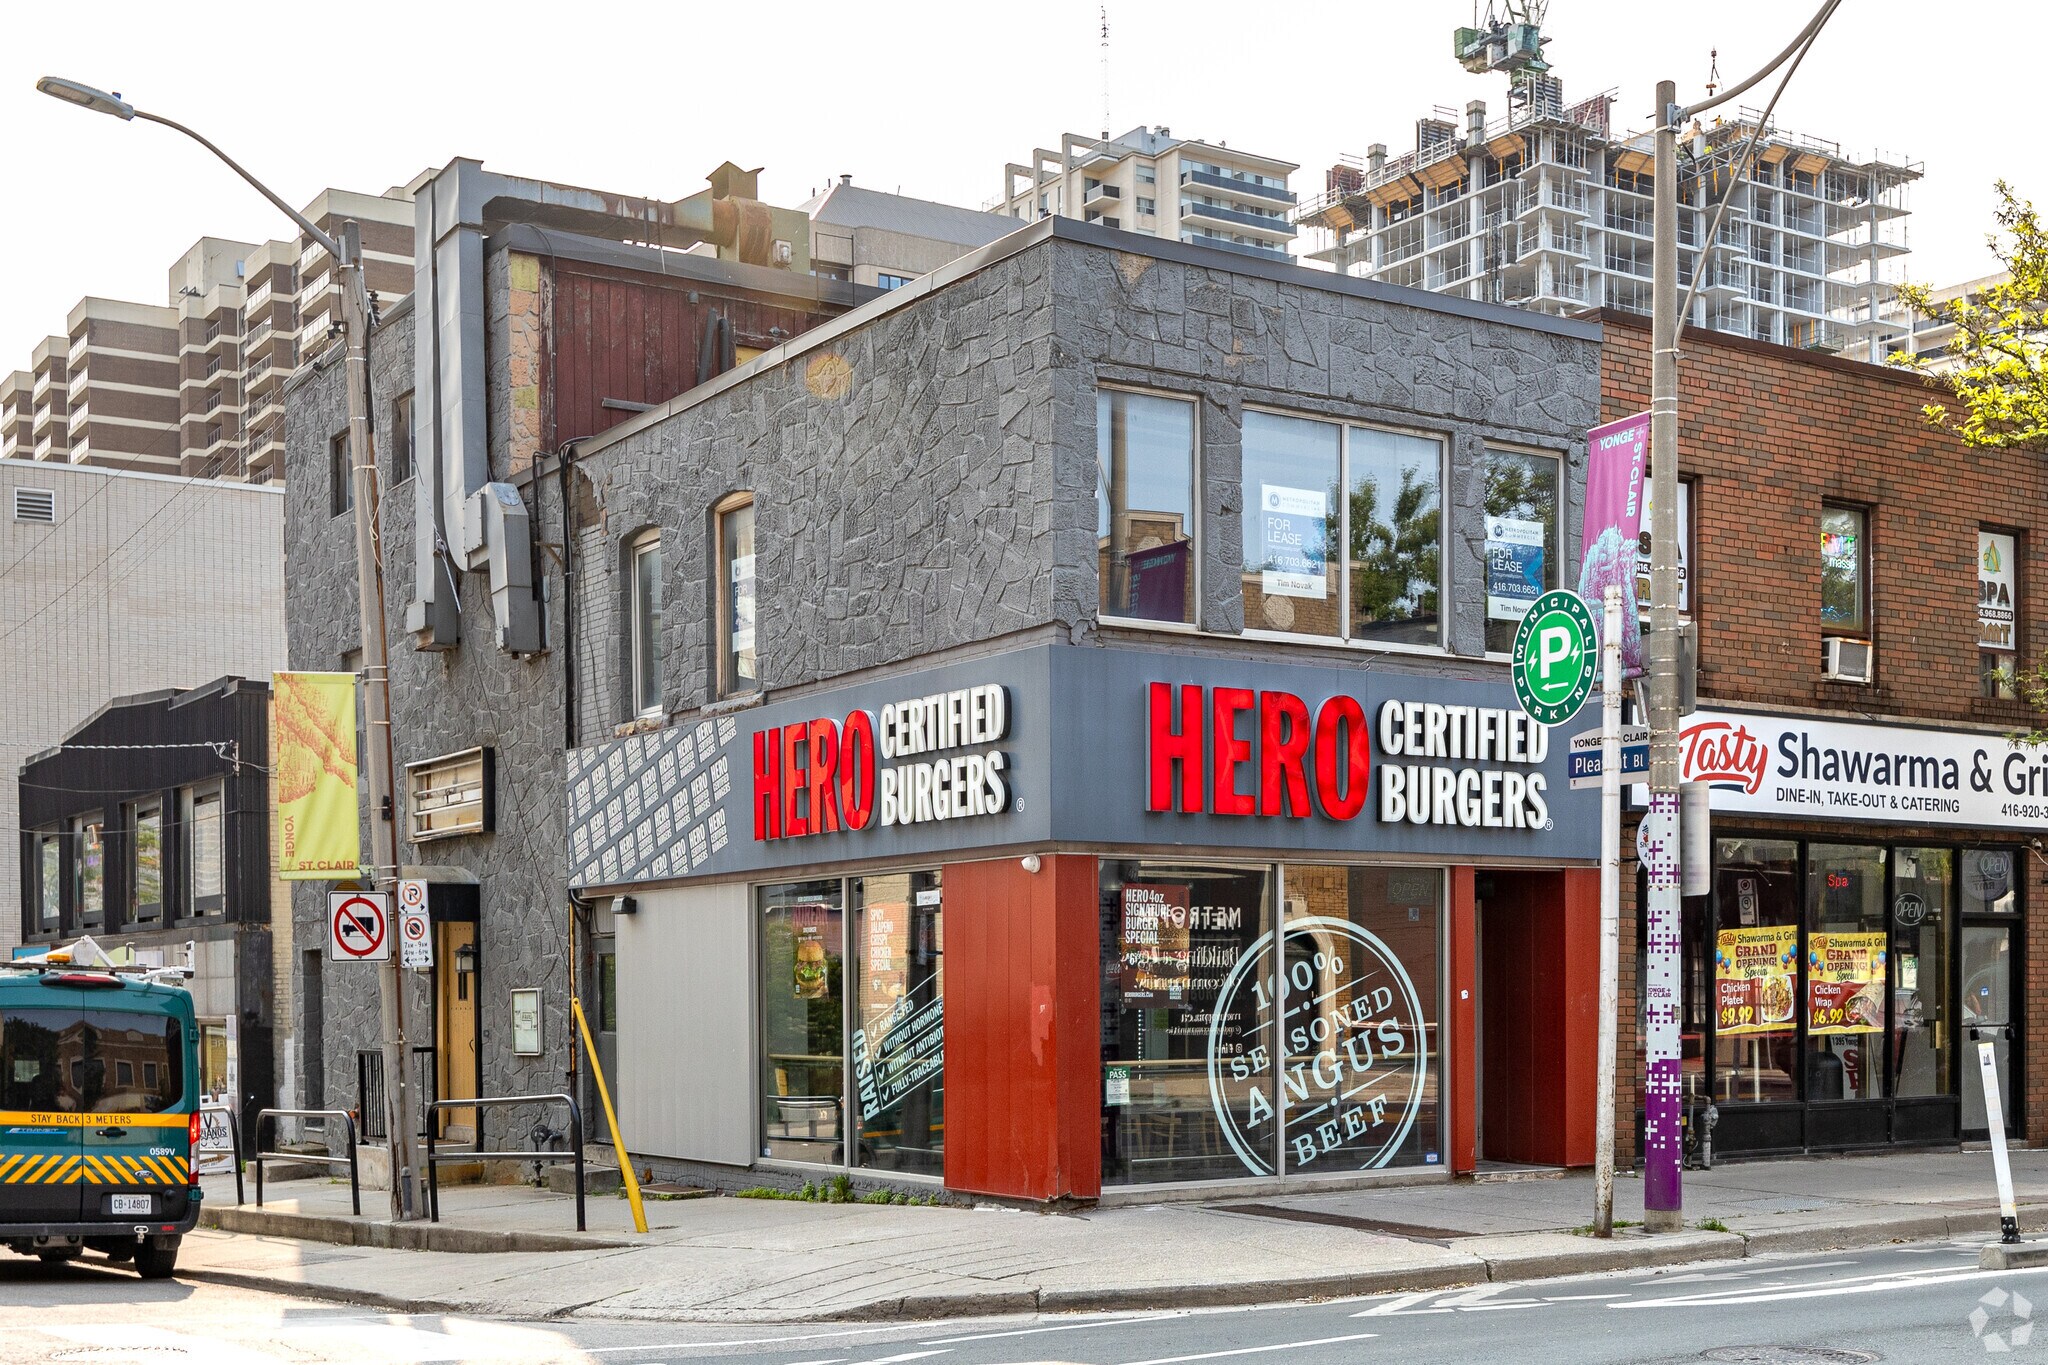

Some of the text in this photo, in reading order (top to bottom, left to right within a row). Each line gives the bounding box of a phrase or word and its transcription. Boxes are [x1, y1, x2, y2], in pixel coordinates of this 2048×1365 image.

[1600, 429, 1635, 451] YONGE
[1626, 441, 1643, 517] ST. CLAIR
[1267, 517, 1291, 532] FOR
[1267, 530, 1302, 546] LEASE
[1492, 547, 1513, 559] FOR
[1268, 555, 1321, 569] 416.703.6621
[1492, 559, 1523, 573] LEASE
[1277, 579, 1313, 590] Tim Novak
[1492, 582, 1539, 595] 416.703.6621
[1500, 604, 1529, 613] Tim Nova
[1516, 597, 1592, 659] MUNICIPAL
[1540, 626, 1572, 679] P
[1517, 664, 1592, 720] PARKING
[880, 683, 1007, 760] CERTIFIED
[1378, 699, 1549, 764] CERTIFIED
[1574, 732, 1648, 749] YONGE CLAIR
[1146, 681, 1370, 822] HERO
[1679, 721, 1769, 795] Tasty
[1777, 731, 1960, 791] Shawarma
[1970, 749, 1994, 793] &
[1633, 754, 1644, 768] Bl
[753, 708, 878, 841] HERO
[881, 750, 1008, 827] BURGERS
[1378, 764, 1548, 830] BURGERS
[1776, 787, 1960, 813] DINE-IN, TAKE-OUT & CATERING
[284, 815, 295, 858] YONGE
[299, 860, 355, 871] ST. CLAIR
[1828, 874, 1849, 889] Spa
[1126, 888, 1165, 903] HERO 4oz
[1125, 903, 1172, 917] SIGNATURE
[1895, 901, 1924, 918] OPEN
[1125, 917, 1159, 930] BURGER
[1125, 930, 1159, 944] SPECIAL
[1718, 932, 1737, 946] Tasty
[1737, 931, 1775, 944] Shawarma
[1776, 931, 1782, 941] &
[1829, 938, 1866, 948] Shawarma
[1867, 938, 1872, 947] &
[870, 946, 892, 959] CHICKEN
[1735, 943, 1777, 957] GRAND
[1826, 949, 1867, 961] GRAND
[870, 959, 892, 971] SPECIAL
[1736, 956, 1777, 969] OPENING!
[1827, 961, 1868, 972] OPENING!
[1721, 983, 1750, 994] Chicken
[1721, 996, 1744, 1006] Plates
[1815, 997, 1833, 1007] Wrap
[880, 999, 914, 1032] RANGE-FED
[1721, 1006, 1754, 1025] $9.99
[1813, 1008, 1844, 1025] $6.99
[882, 1027, 912, 1053] WITHOUT
[887, 1045, 915, 1074] WITHOUT
[853, 1028, 880, 1121] RAISED
[1109, 1070, 1127, 1079] PASS
[1247, 1016, 1405, 1130] ANGUS
[31, 1114, 132, 1124] STAY BACK 3 METERS
[1291, 1093, 1388, 1167] BEEF
[150, 1147, 176, 1156] 0589V
